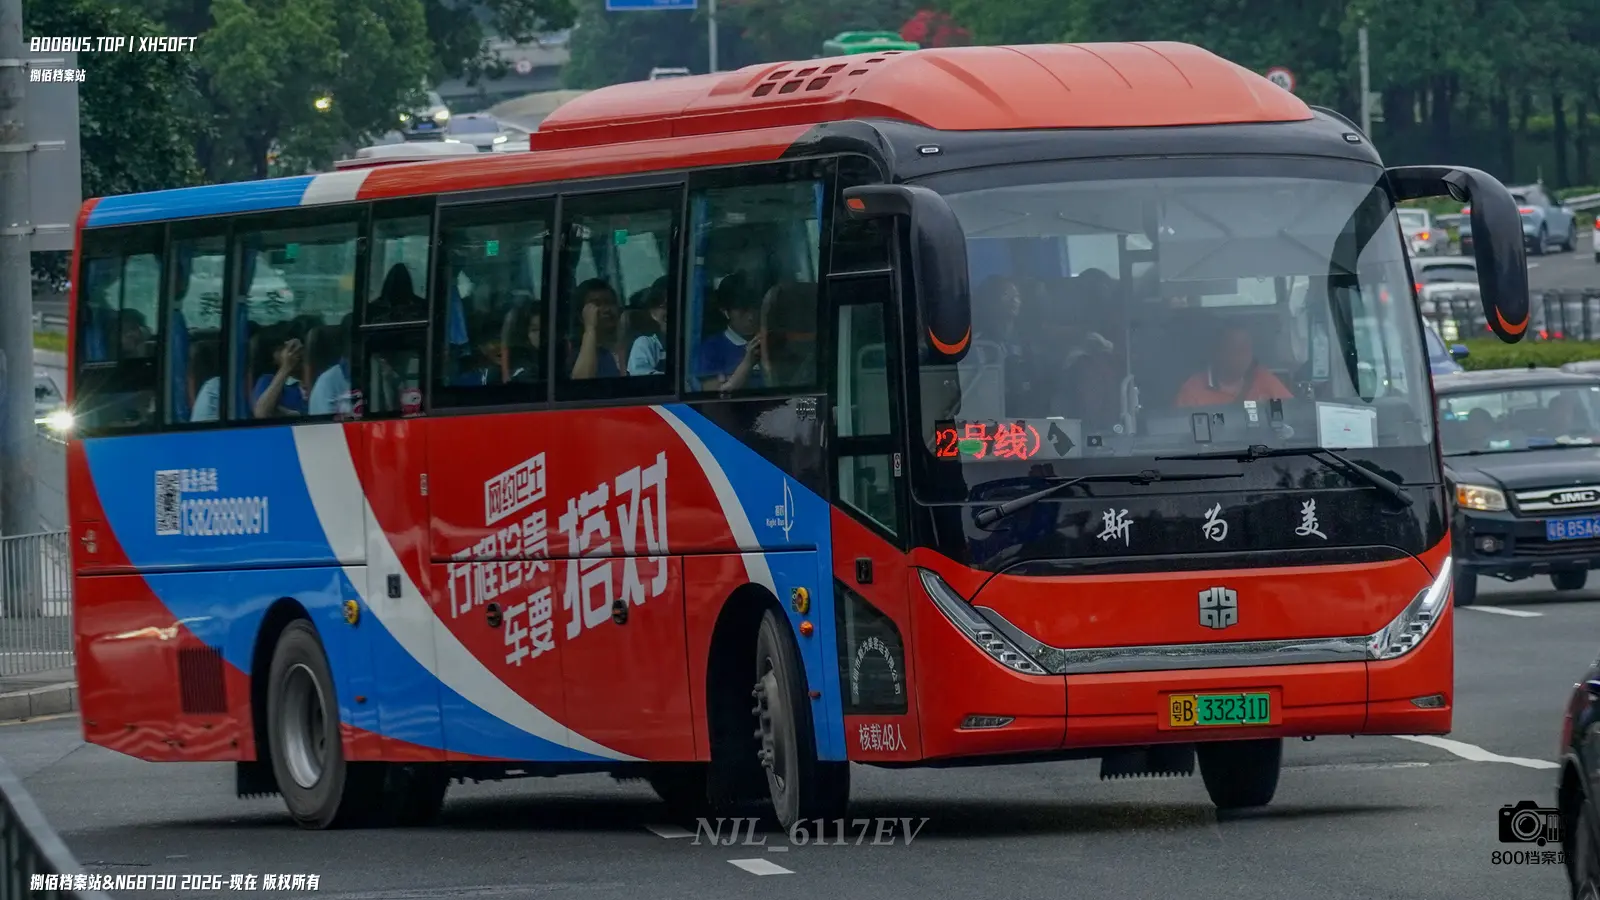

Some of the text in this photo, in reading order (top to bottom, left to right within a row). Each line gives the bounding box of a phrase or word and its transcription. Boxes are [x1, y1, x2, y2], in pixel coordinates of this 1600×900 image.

[488, 459, 545, 517] 网约巴士
[1553, 491, 1594, 503] JMC
[559, 451, 669, 640] 搭对
[1097, 498, 1328, 547] 斯为美
[448, 509, 549, 619] 行程珍贵
[503, 587, 555, 666] 车要
[1203, 698, 1269, 721] 33231D
[859, 723, 907, 751] 核载48人
